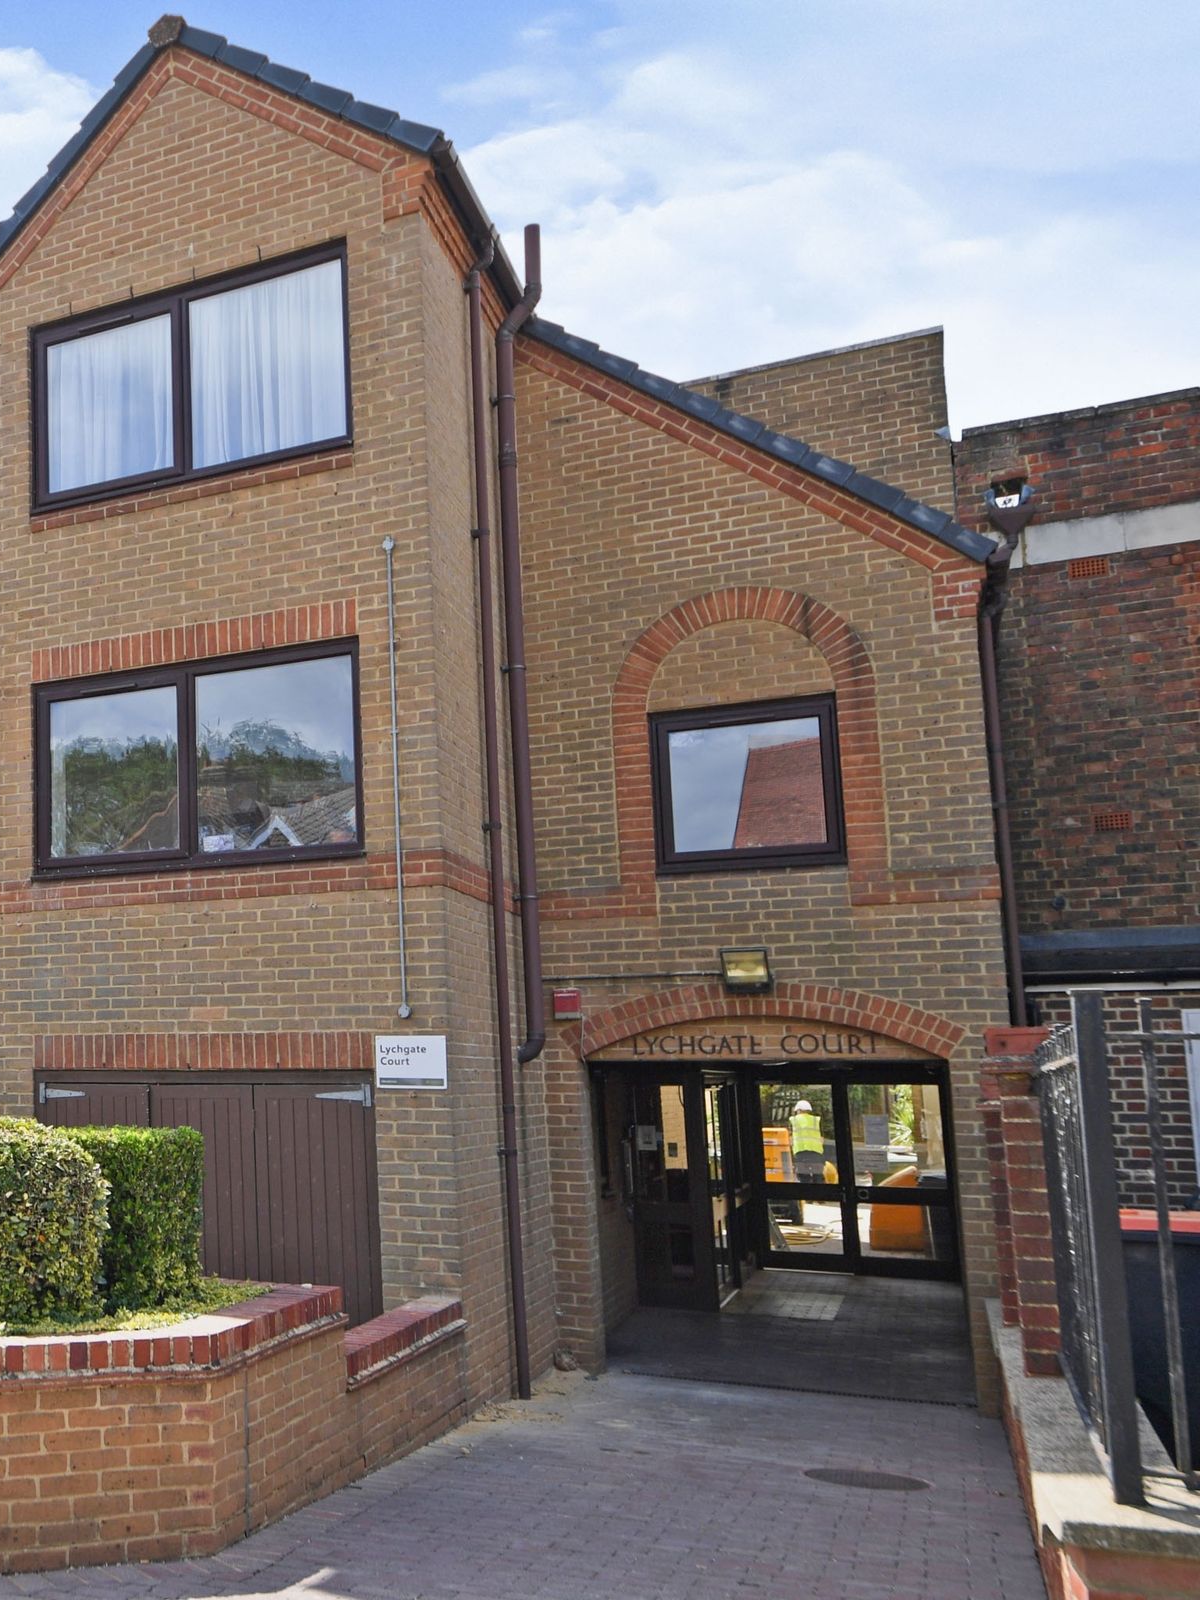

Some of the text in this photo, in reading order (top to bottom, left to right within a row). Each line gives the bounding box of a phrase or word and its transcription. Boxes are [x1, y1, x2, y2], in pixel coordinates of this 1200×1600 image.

[633, 1034, 876, 1055] LYCHGATE COURT
[380, 1045, 427, 1055] Lychgate
[380, 1057, 410, 1065] Court
